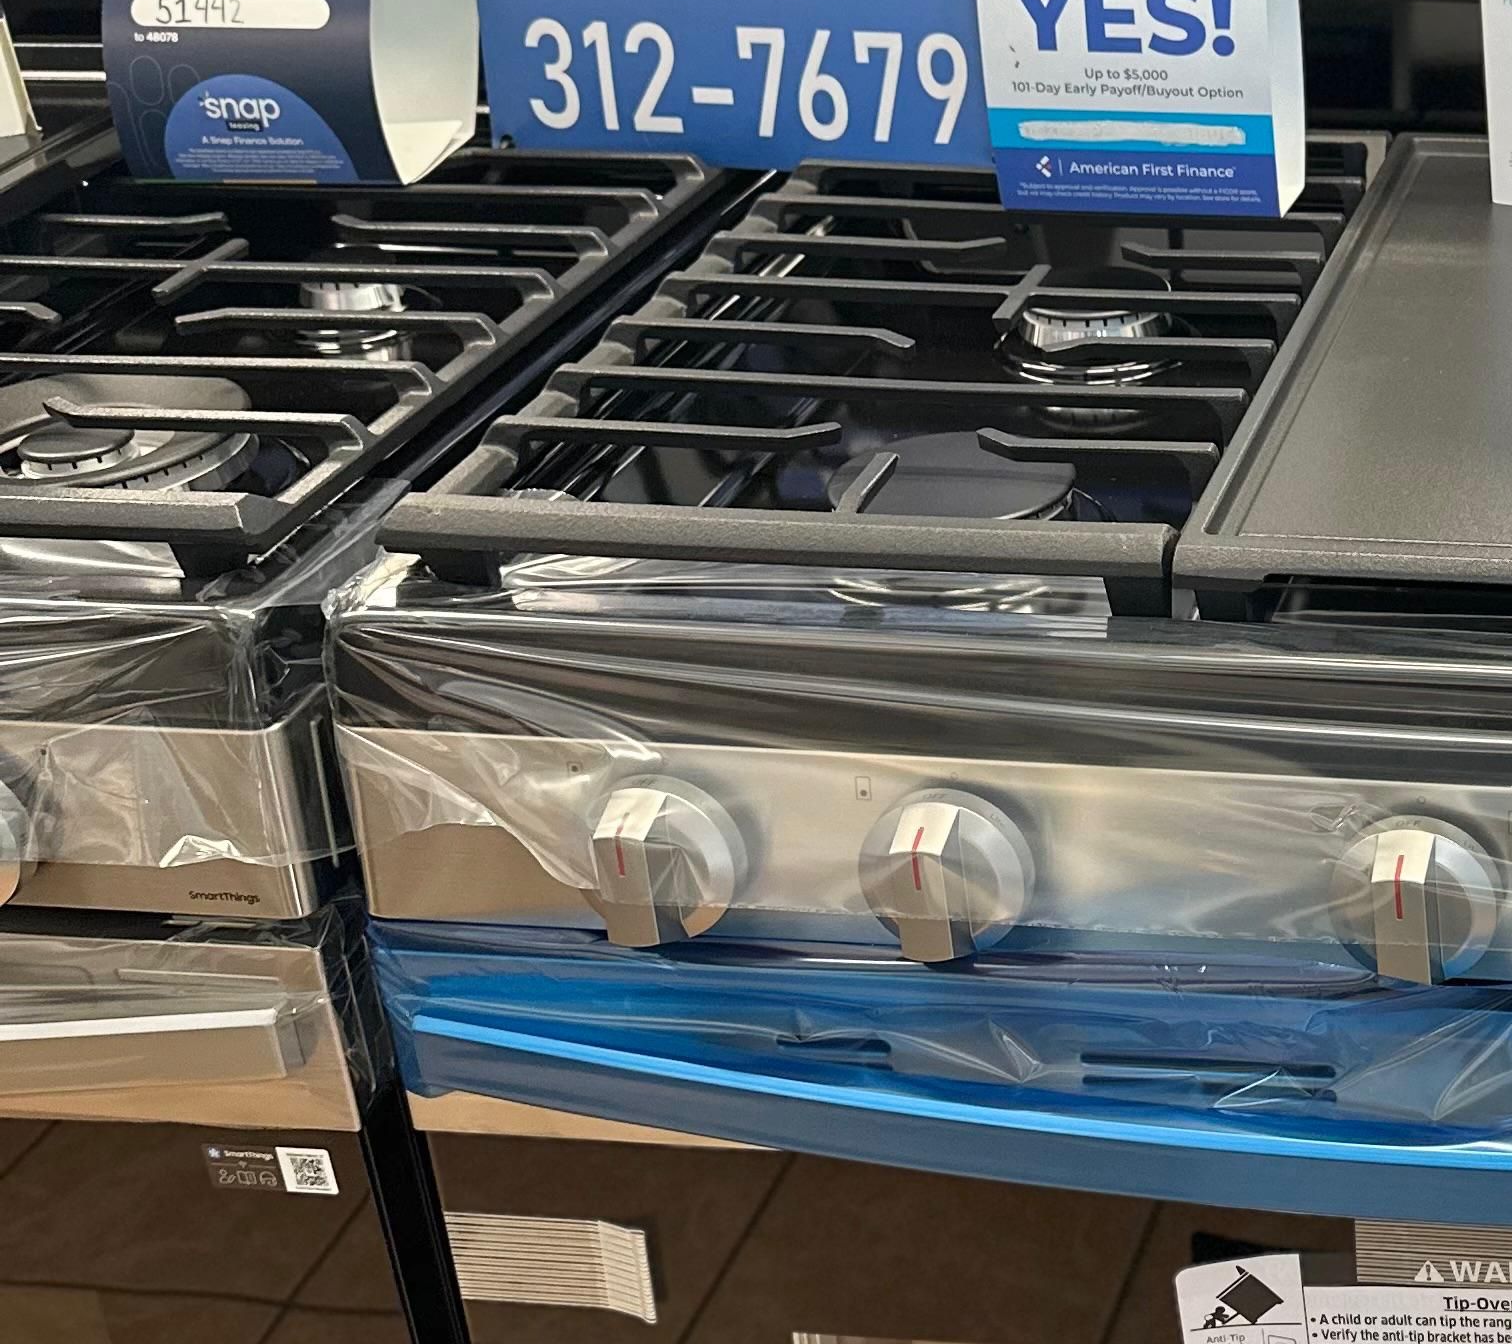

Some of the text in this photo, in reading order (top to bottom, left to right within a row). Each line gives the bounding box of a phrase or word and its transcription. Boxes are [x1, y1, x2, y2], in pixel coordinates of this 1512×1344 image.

[134, 32, 144, 42] to
[522, 16, 970, 145] 312-7679
[1084, 68, 1169, 82] Up to $5,000
[1012, 81, 1244, 99] 101-Day Early Payoff/Buyout Option
[204, 97, 281, 128] snap
[1069, 161, 1235, 178] American First Finance
[188, 890, 260, 905] SmartThings
[1319, 1314, 1330, 1325] A
[1331, 1313, 1362, 1326] child
[1364, 1316, 1378, 1326] or
[1381, 1314, 1413, 1326] adult
[1415, 1317, 1434, 1326] can
[1436, 1316, 1456, 1330] tip
[1459, 1316, 1480, 1328] the
[1321, 1329, 1358, 1342] Verify
[1361, 1330, 1381, 1341] the
[1382, 1331, 1424, 1344] anti-tip
[1427, 1331, 1472, 1343] bracket
[1474, 1332, 1494, 1343] has
